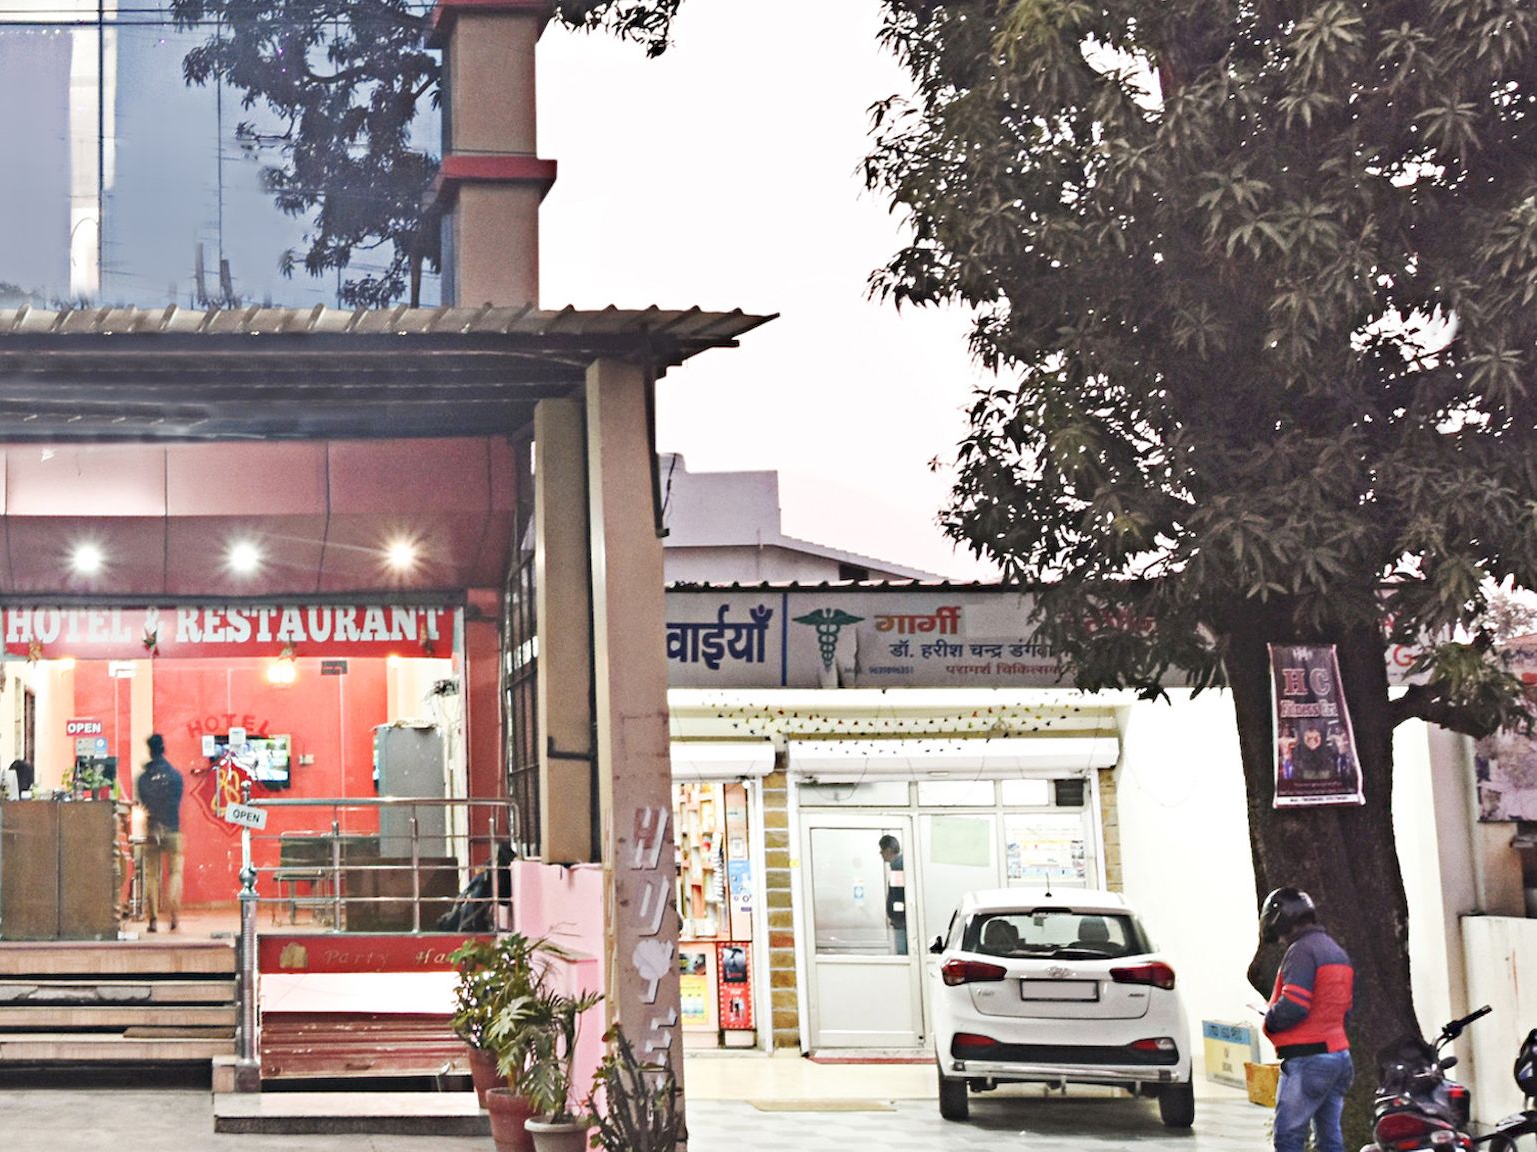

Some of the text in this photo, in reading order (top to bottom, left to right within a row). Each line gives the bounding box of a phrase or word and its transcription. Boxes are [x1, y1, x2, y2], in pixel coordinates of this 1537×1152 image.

[6, 607, 133, 644] HOTEL
[175, 605, 444, 643] RESTAURANT
[874, 605, 962, 635] गार्गी
[666, 604, 774, 670] वाईयाँ
[889, 639, 914, 659] डॉ.
[920, 638, 963, 659] हरीश
[969, 644, 1003, 659] चन्द्र
[67, 722, 102, 735] OPEN
[186, 713, 271, 739] HOTEL
[232, 807, 261, 824] OPEN
[324, 949, 388, 971] Party
